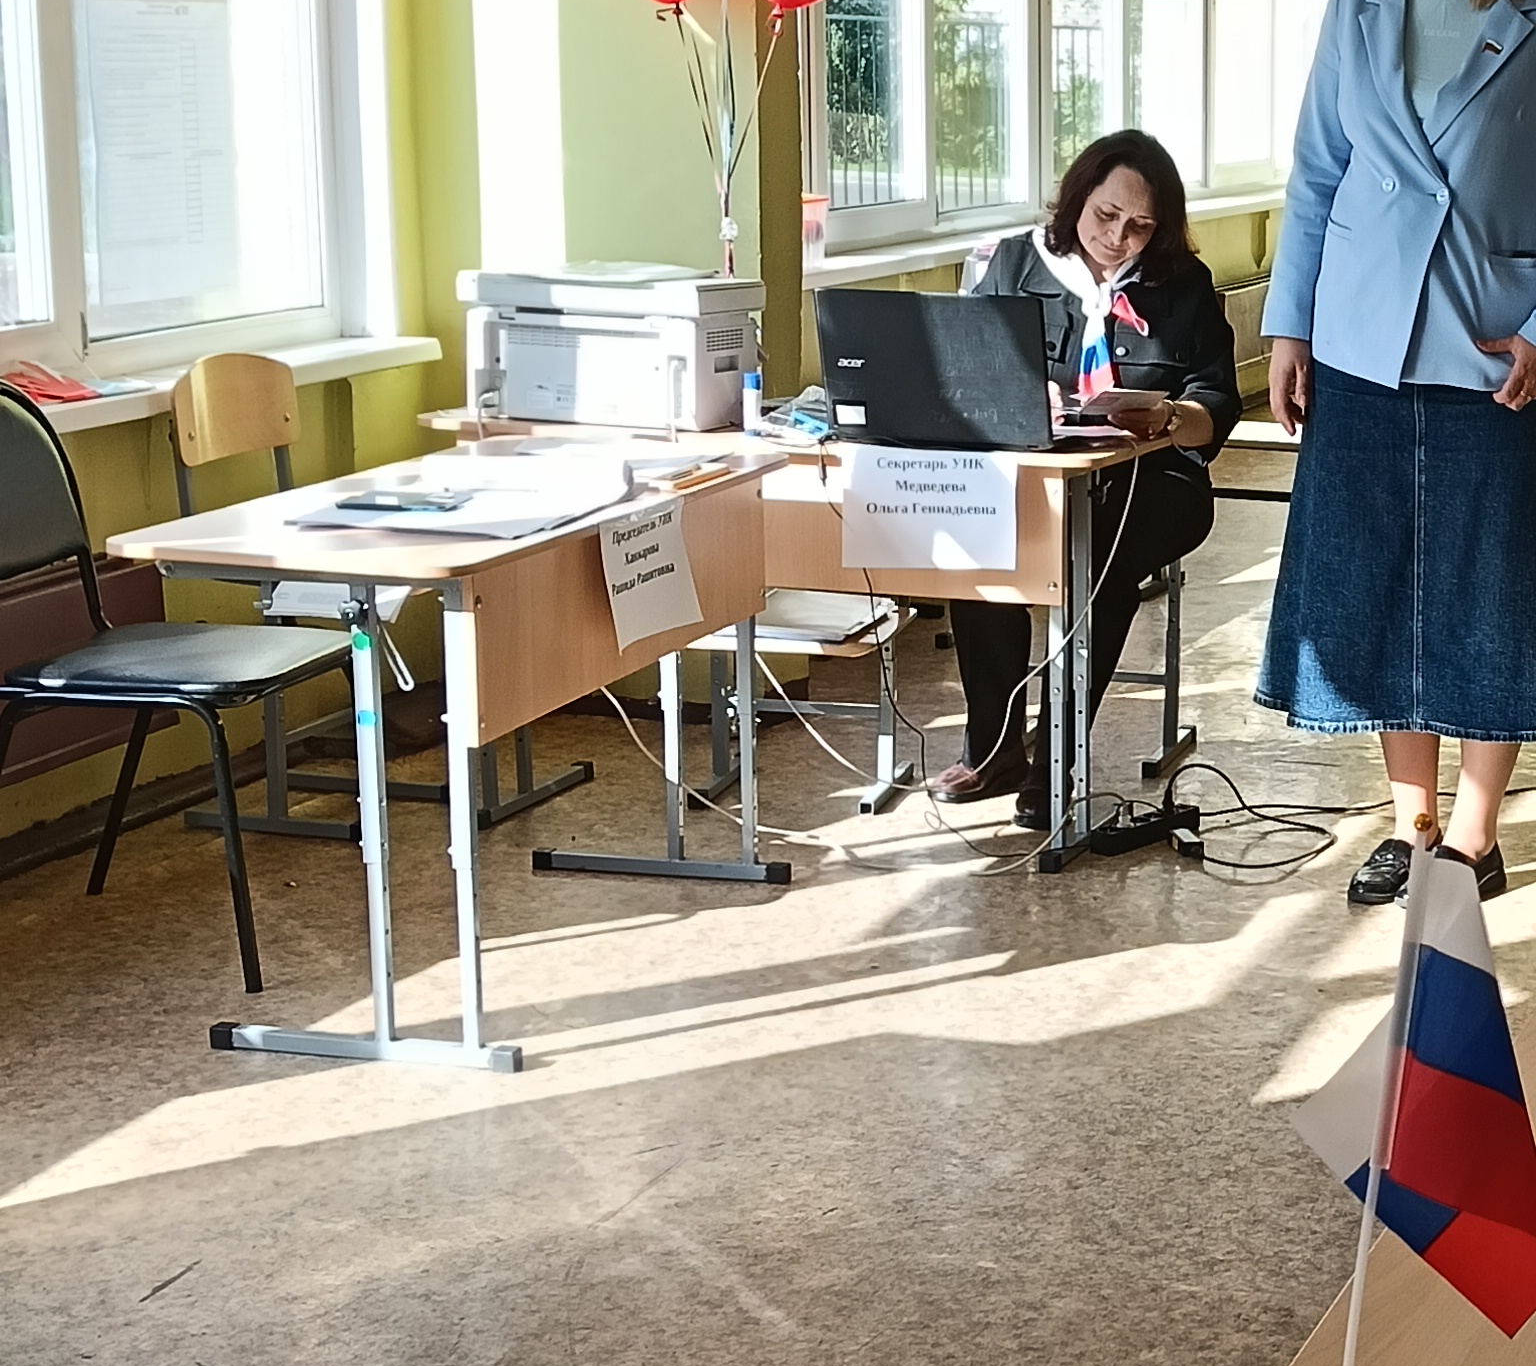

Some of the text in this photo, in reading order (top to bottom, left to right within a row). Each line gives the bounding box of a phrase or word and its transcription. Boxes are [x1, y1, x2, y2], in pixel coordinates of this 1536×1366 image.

[837, 358, 866, 368] acer
[877, 457, 985, 472] Секретарь УИК
[895, 480, 966, 494] Медведева
[866, 502, 996, 516] Ольга Геннадьевна
